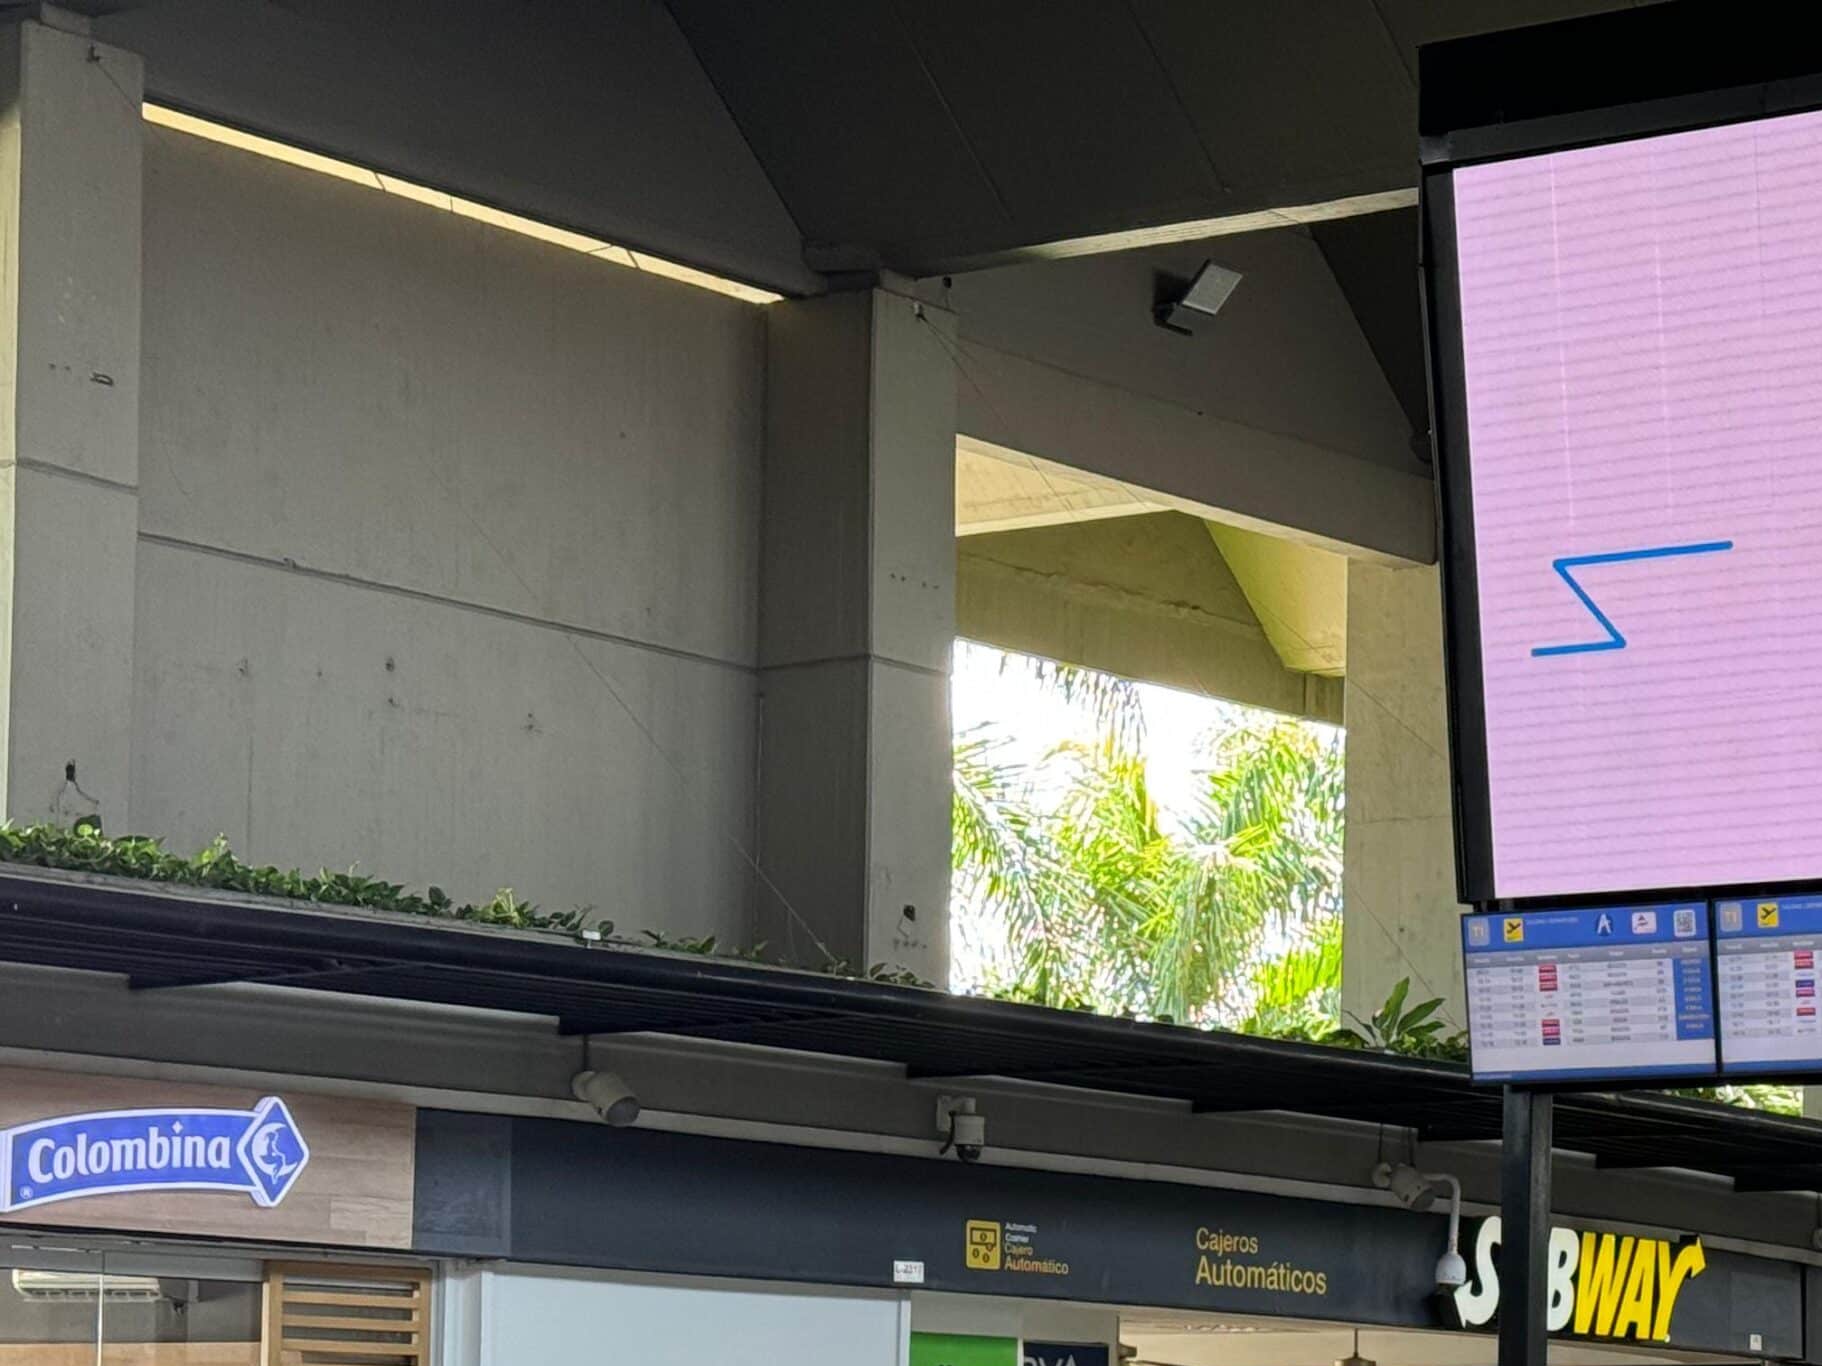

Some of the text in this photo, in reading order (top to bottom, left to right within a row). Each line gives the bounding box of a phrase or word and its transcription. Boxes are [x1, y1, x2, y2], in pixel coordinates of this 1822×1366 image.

[28, 1120, 231, 1184] Colombina
[1196, 1227, 1259, 1257] Cajeros
[1195, 1255, 1327, 1295] Automáticos
[1454, 1216, 1706, 1343] SBWAY
